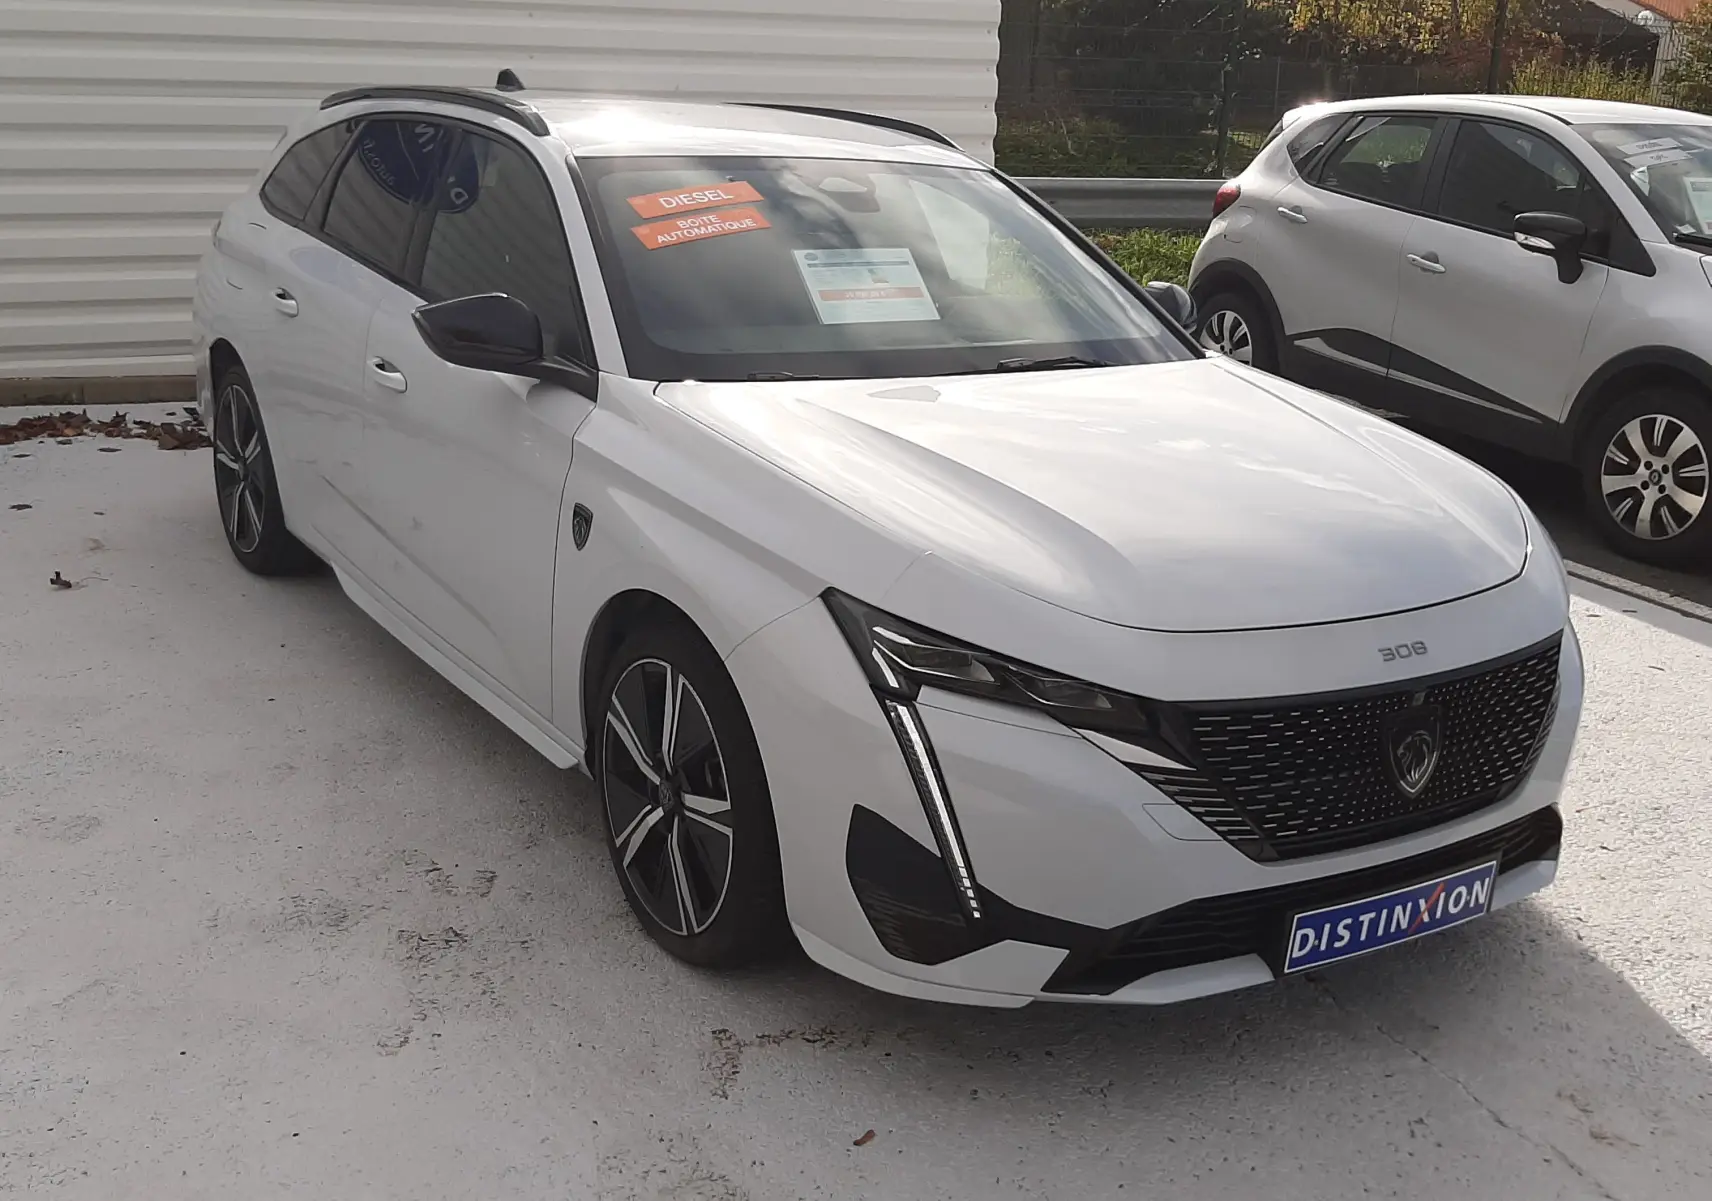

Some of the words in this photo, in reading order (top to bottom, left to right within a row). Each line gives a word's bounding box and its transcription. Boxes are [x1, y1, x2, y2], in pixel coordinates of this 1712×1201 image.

[658, 188, 735, 209] DIESEL
[657, 218, 757, 243] AUTOMATIQUE
[676, 214, 721, 229] BOITE
[1377, 640, 1428, 662] 308
[1291, 876, 1490, 959] DISTINXION
